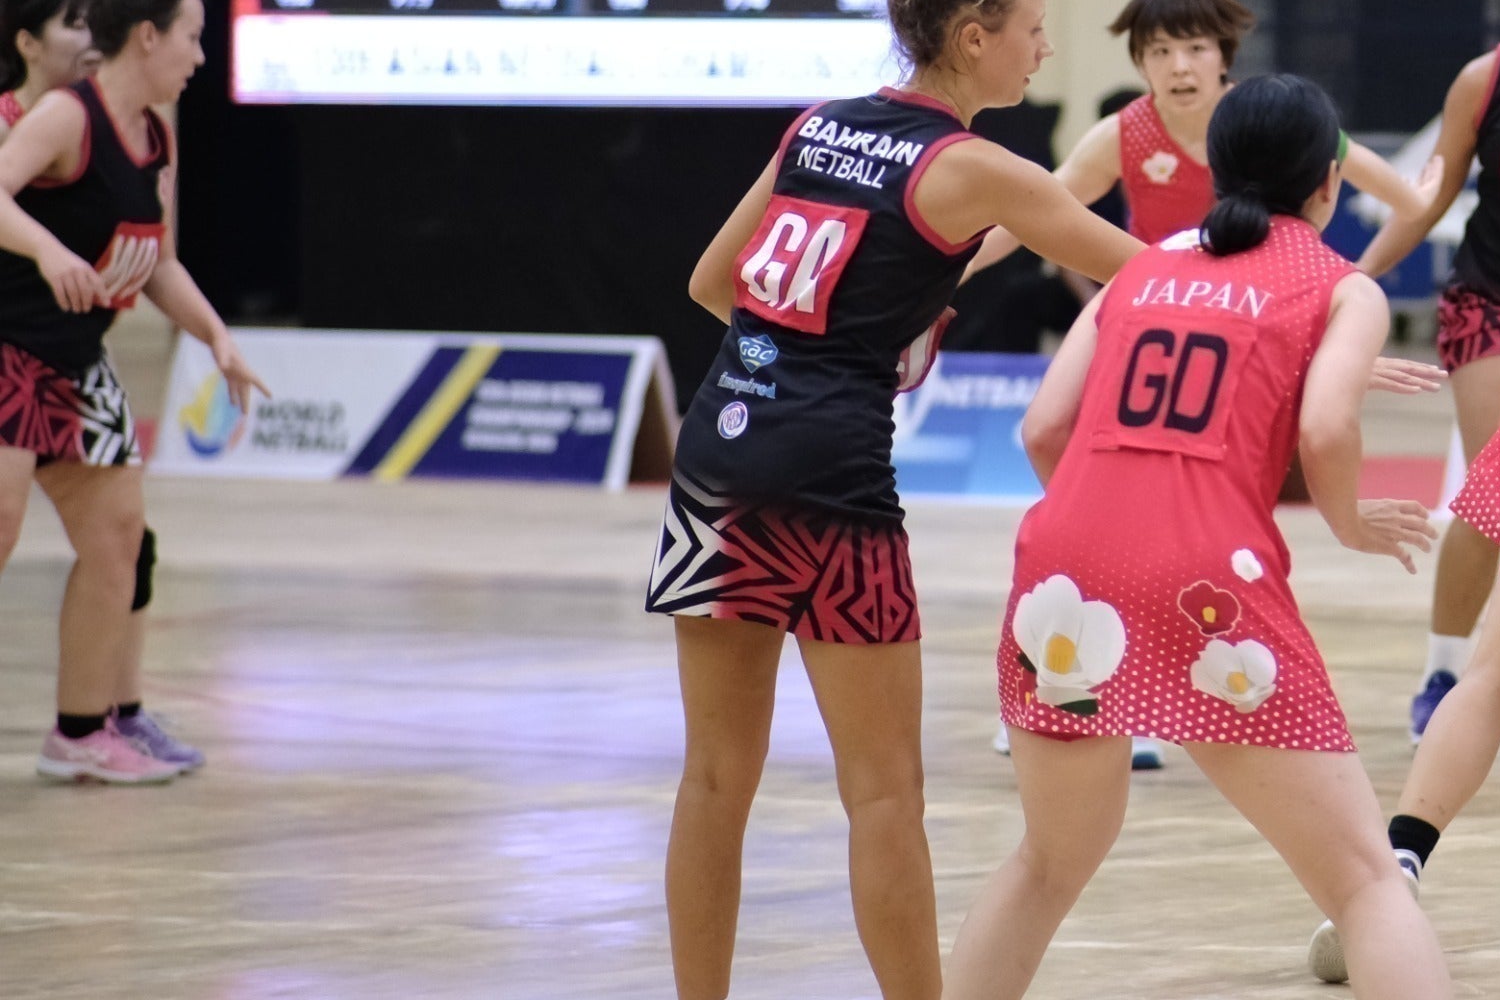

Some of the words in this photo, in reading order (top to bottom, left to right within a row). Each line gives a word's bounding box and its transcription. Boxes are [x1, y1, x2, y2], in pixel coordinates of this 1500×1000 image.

[798, 116, 923, 166] BAHRAIN
[797, 145, 886, 189] NETBALL
[741, 212, 846, 314] GA
[1132, 278, 1275, 319] JAPAN
[1118, 329, 1229, 434] GD
